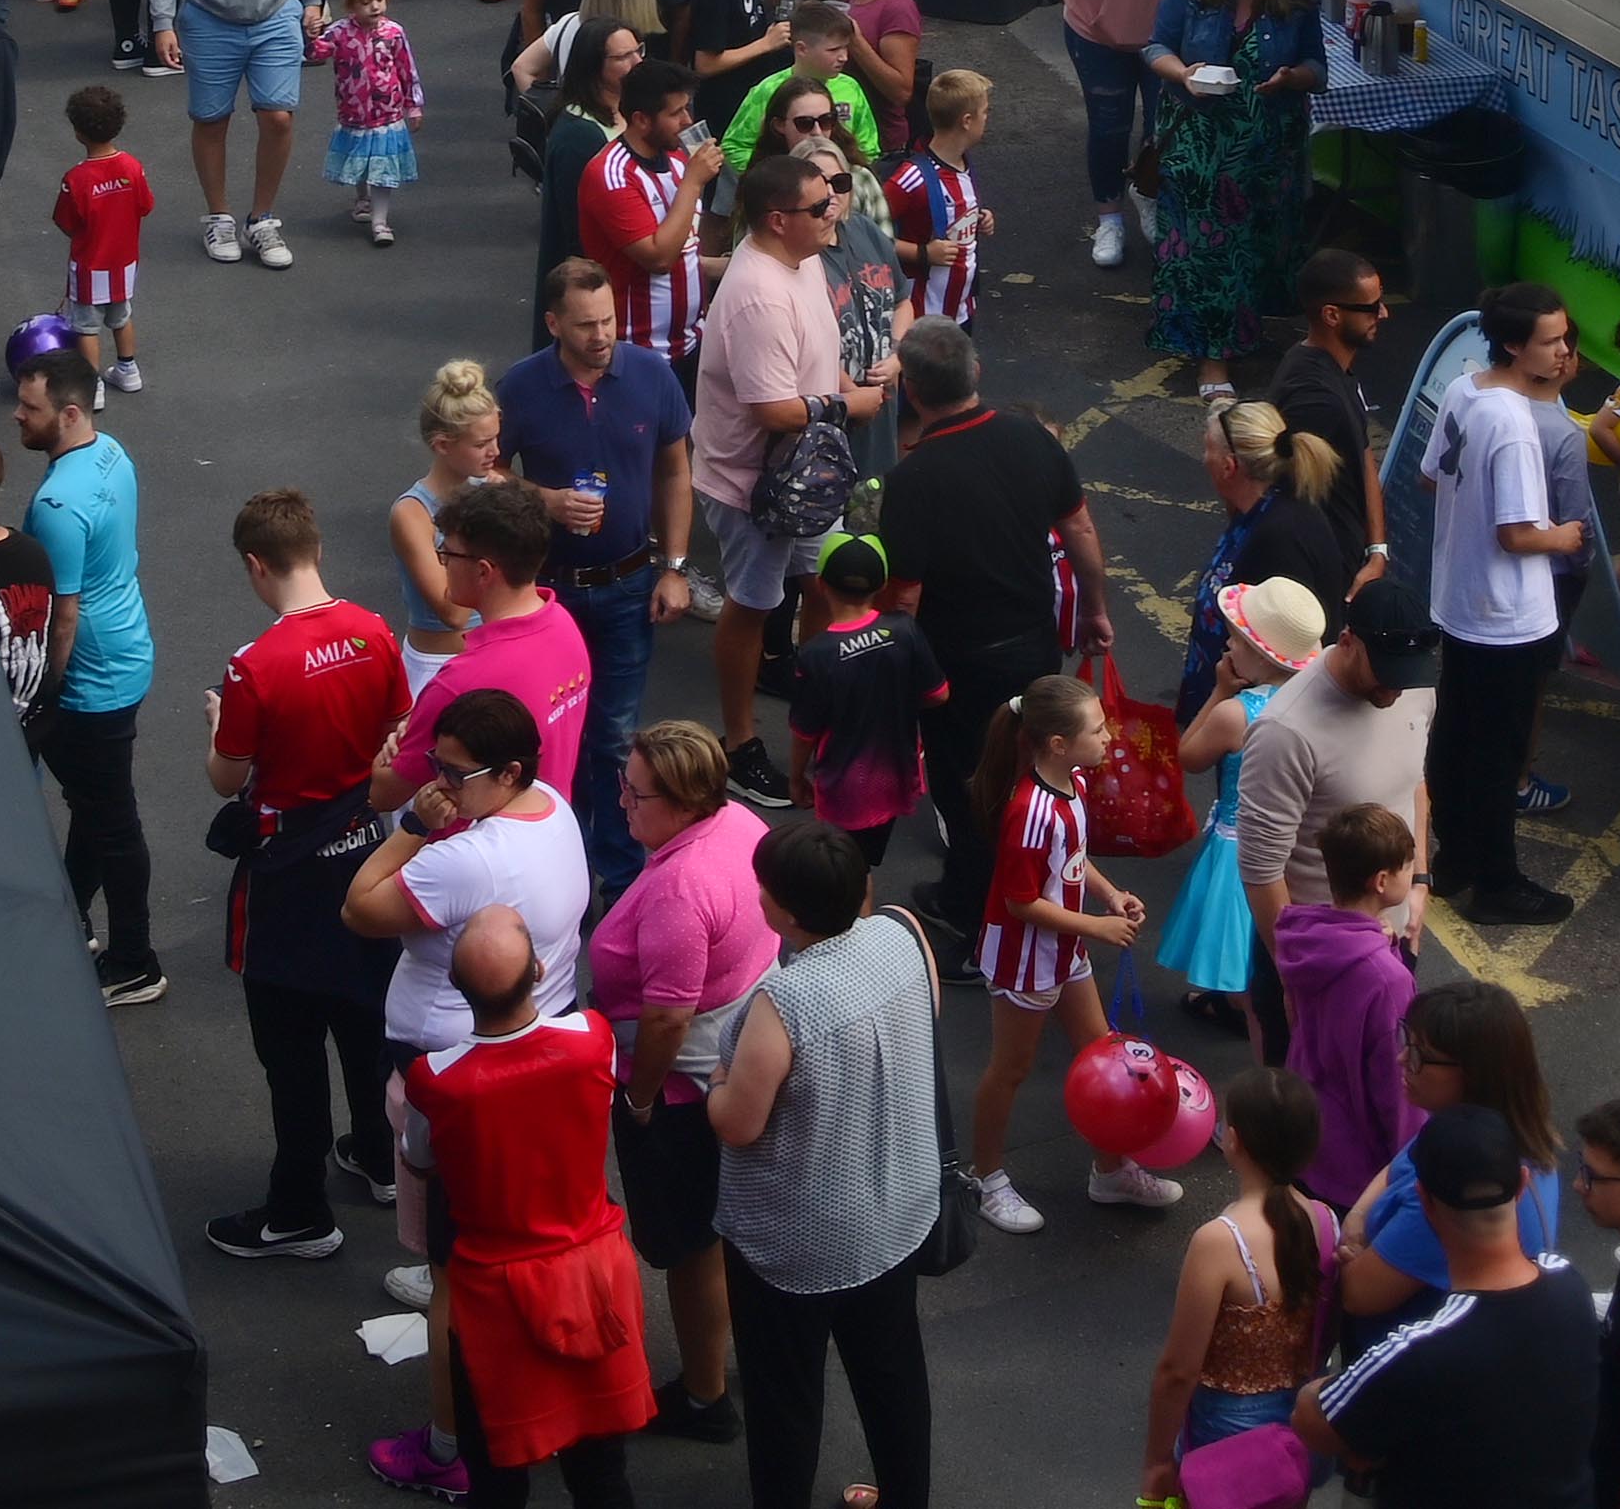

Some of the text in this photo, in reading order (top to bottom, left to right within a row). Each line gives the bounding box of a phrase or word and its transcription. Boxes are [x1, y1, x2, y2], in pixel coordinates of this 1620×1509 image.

[304, 638, 356, 672] AMIA
[840, 630, 884, 657] AMIA
[317, 827, 367, 858] Mobil
